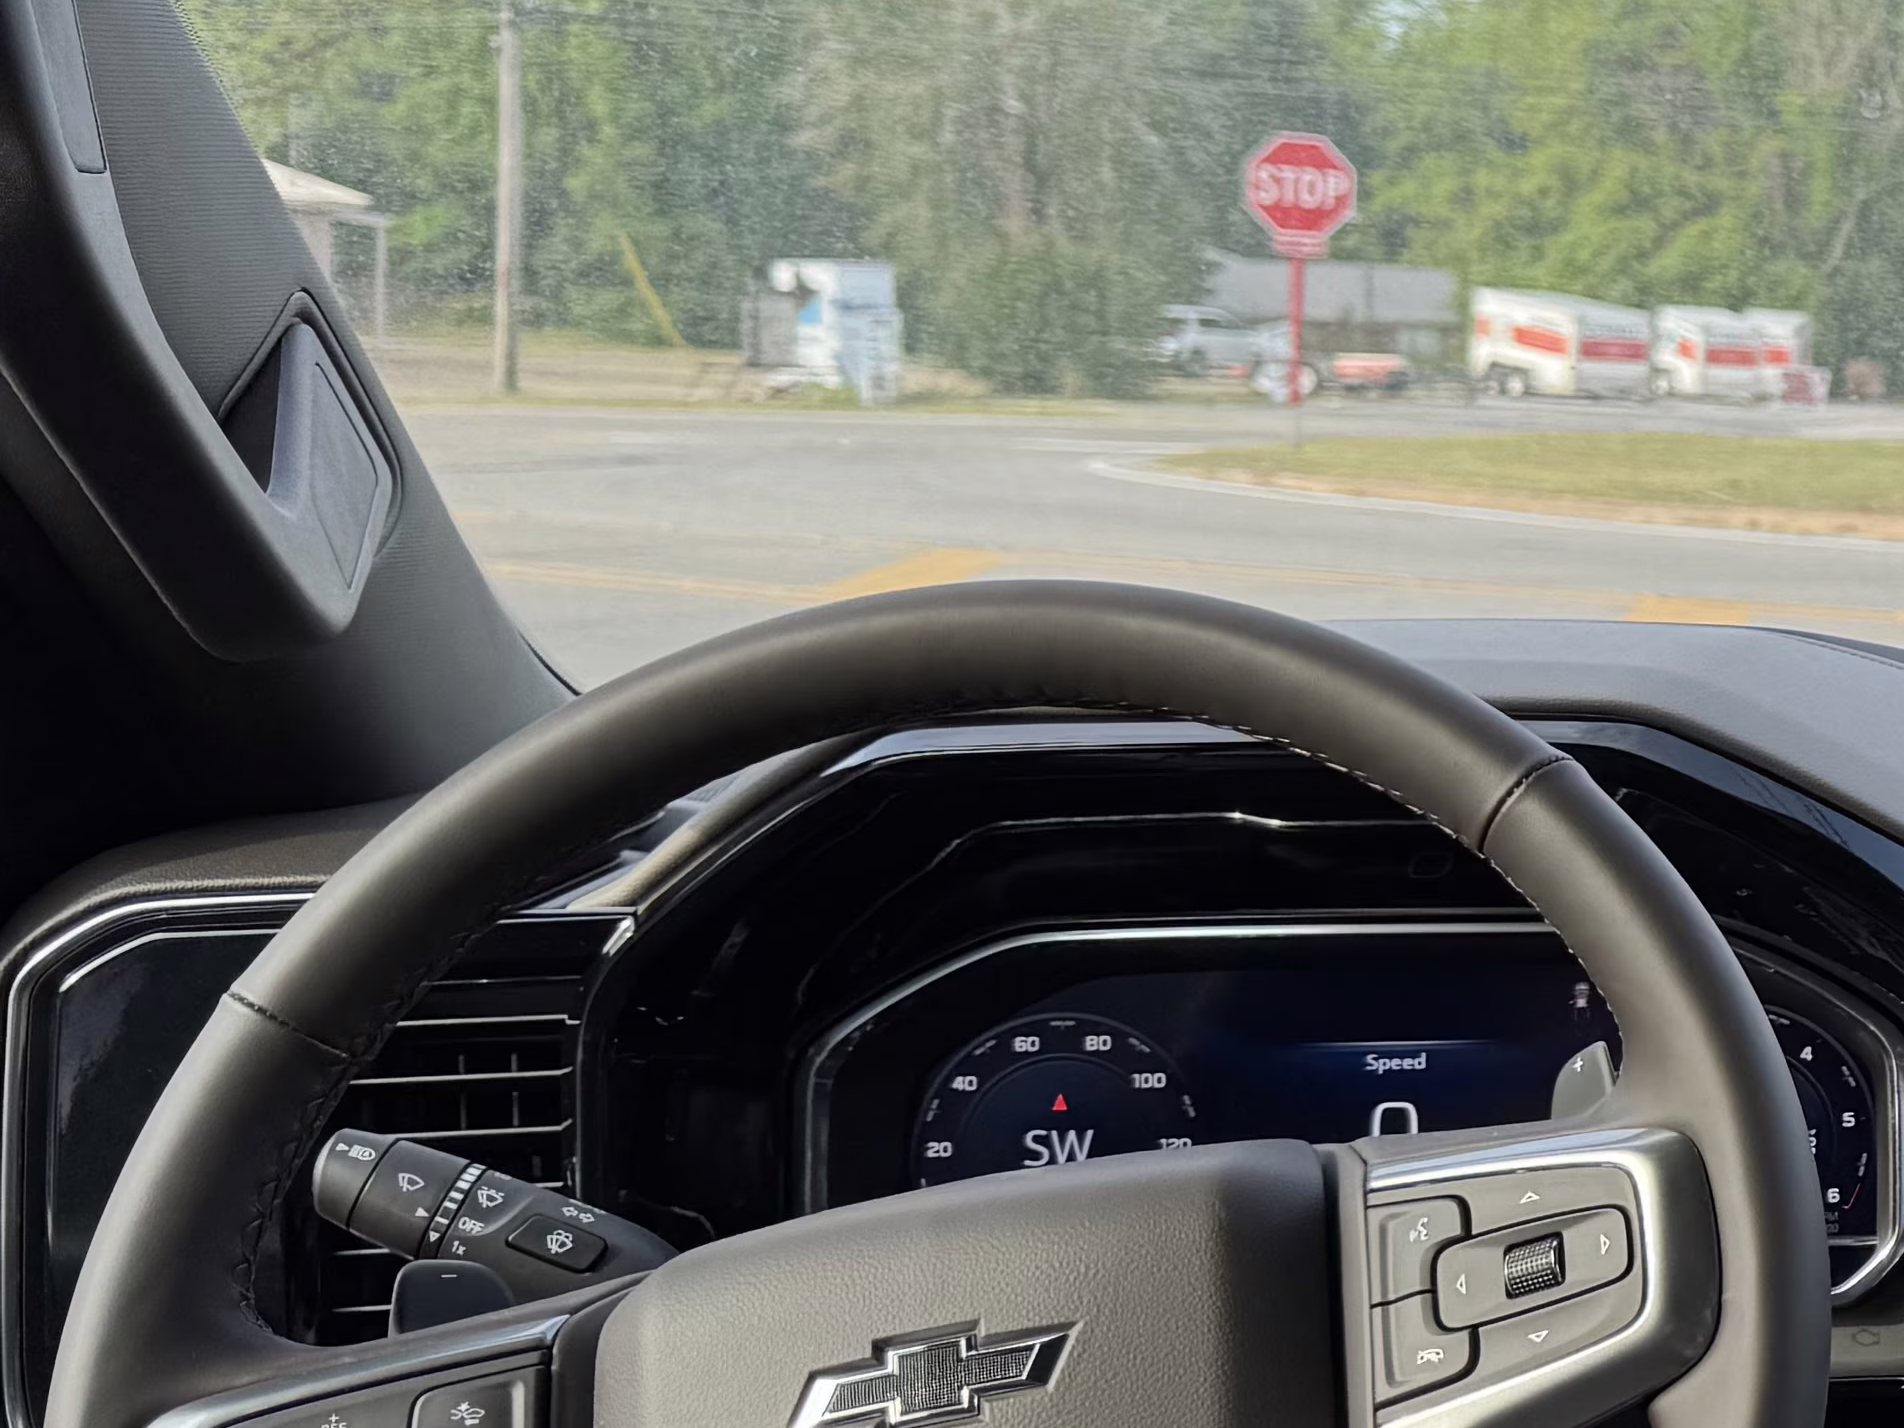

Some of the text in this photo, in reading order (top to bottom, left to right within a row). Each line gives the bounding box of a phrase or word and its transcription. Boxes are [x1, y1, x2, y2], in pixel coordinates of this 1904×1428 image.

[1254, 162, 1350, 210] STOP
[1013, 1035, 1040, 1052] 60
[1084, 1034, 1112, 1052] 80
[1799, 1046, 1814, 1062] 4
[1364, 1053, 1427, 1075] Speed
[951, 1075, 978, 1092] 40
[1131, 1072, 1167, 1089] 100
[1841, 1112, 1856, 1127] 5
[926, 1141, 953, 1158] 20
[1021, 1128, 1095, 1167] SW
[1826, 1188, 1840, 1204] 6
[458, 1216, 485, 1235] OFF
[451, 1240, 467, 1256] 1x
